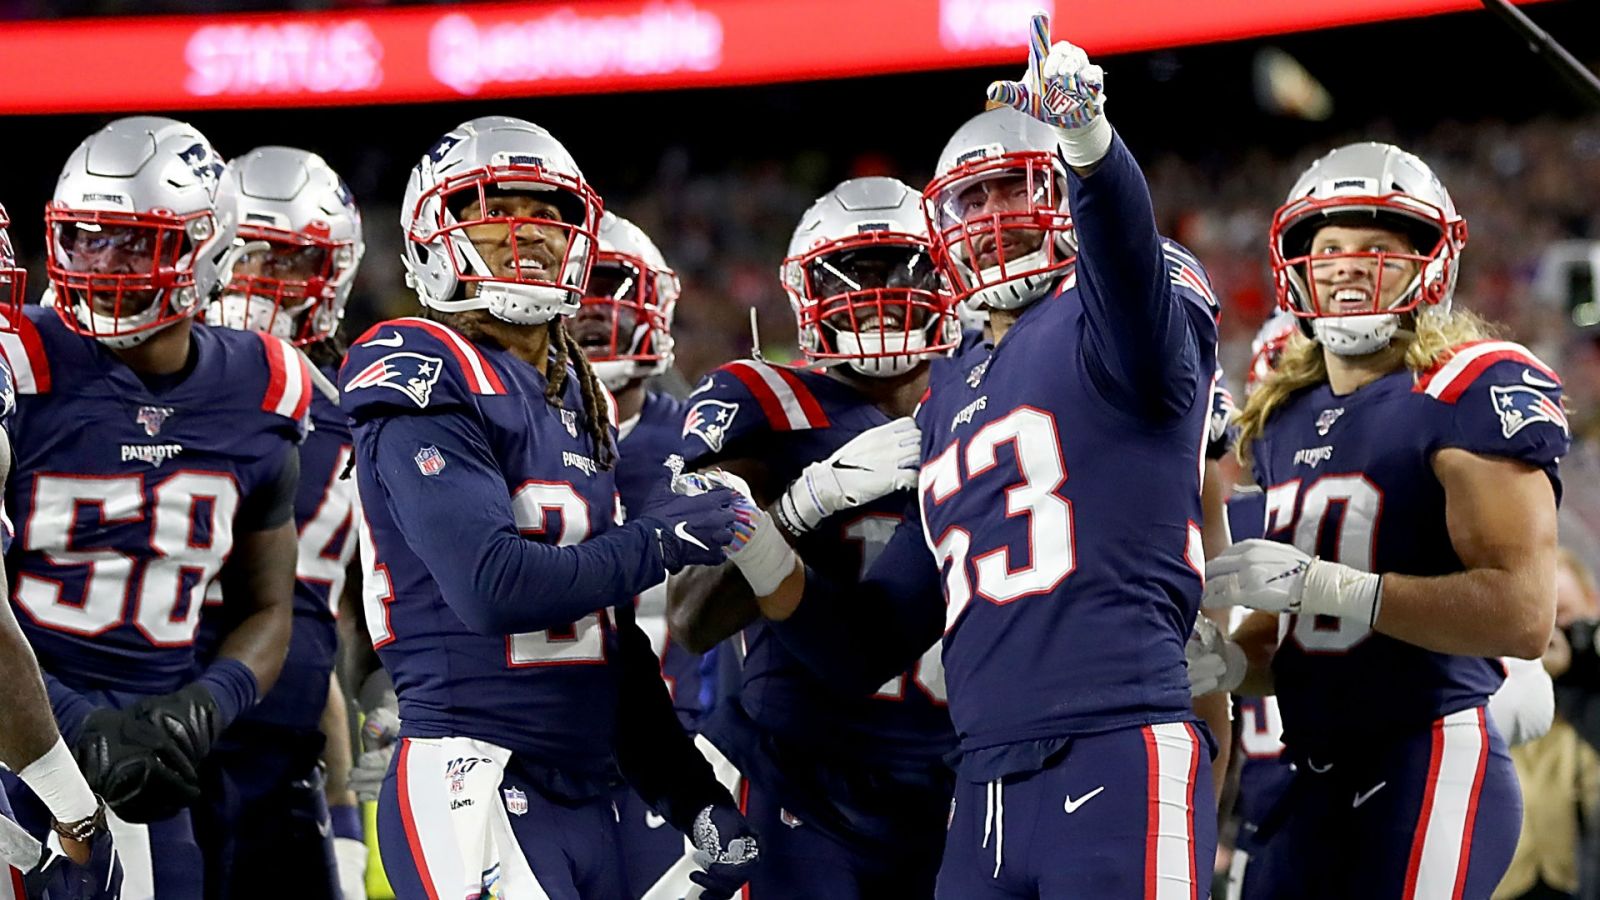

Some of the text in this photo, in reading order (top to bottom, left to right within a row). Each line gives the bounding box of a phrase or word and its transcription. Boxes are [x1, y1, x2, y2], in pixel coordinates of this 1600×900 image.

[186, 22, 382, 95] STATUS
[15, 470, 240, 648] 58
[918, 406, 1077, 635] 53
